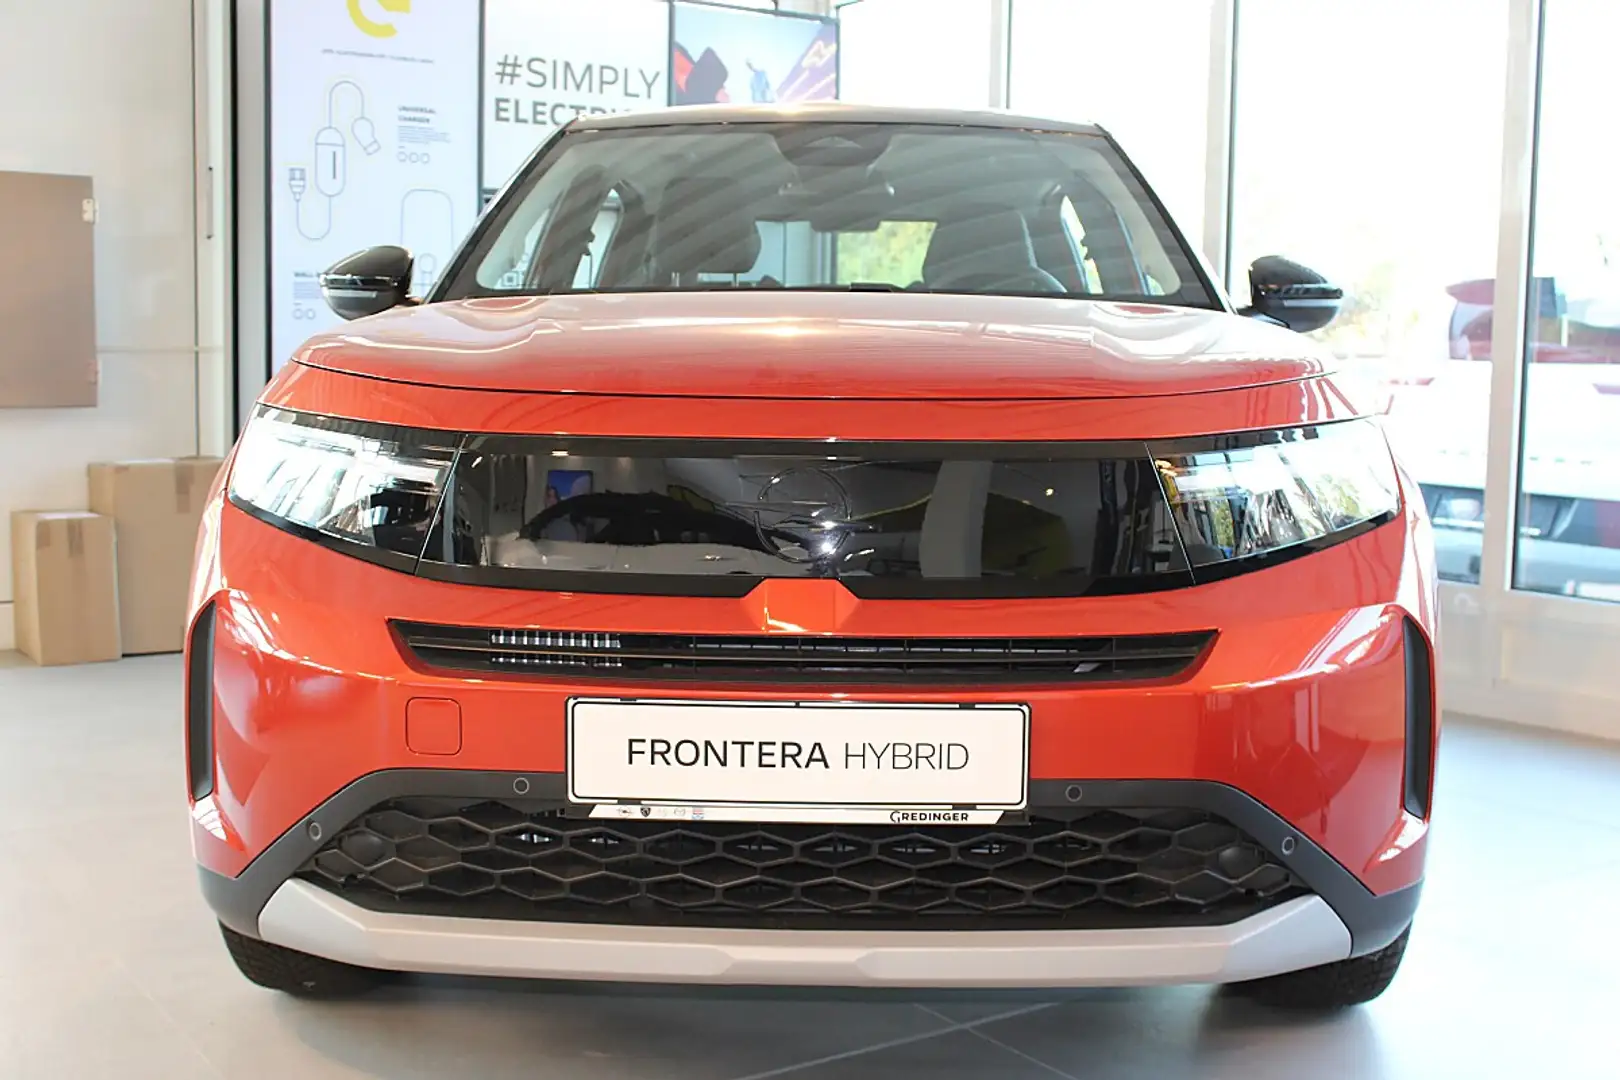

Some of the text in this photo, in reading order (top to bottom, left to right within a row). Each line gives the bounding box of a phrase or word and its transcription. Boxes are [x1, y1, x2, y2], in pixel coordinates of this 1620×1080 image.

[495, 54, 660, 99] #SIMPLY
[628, 738, 970, 770] FRONTERA HYBRID
[889, 811, 969, 823] GREDINGER
